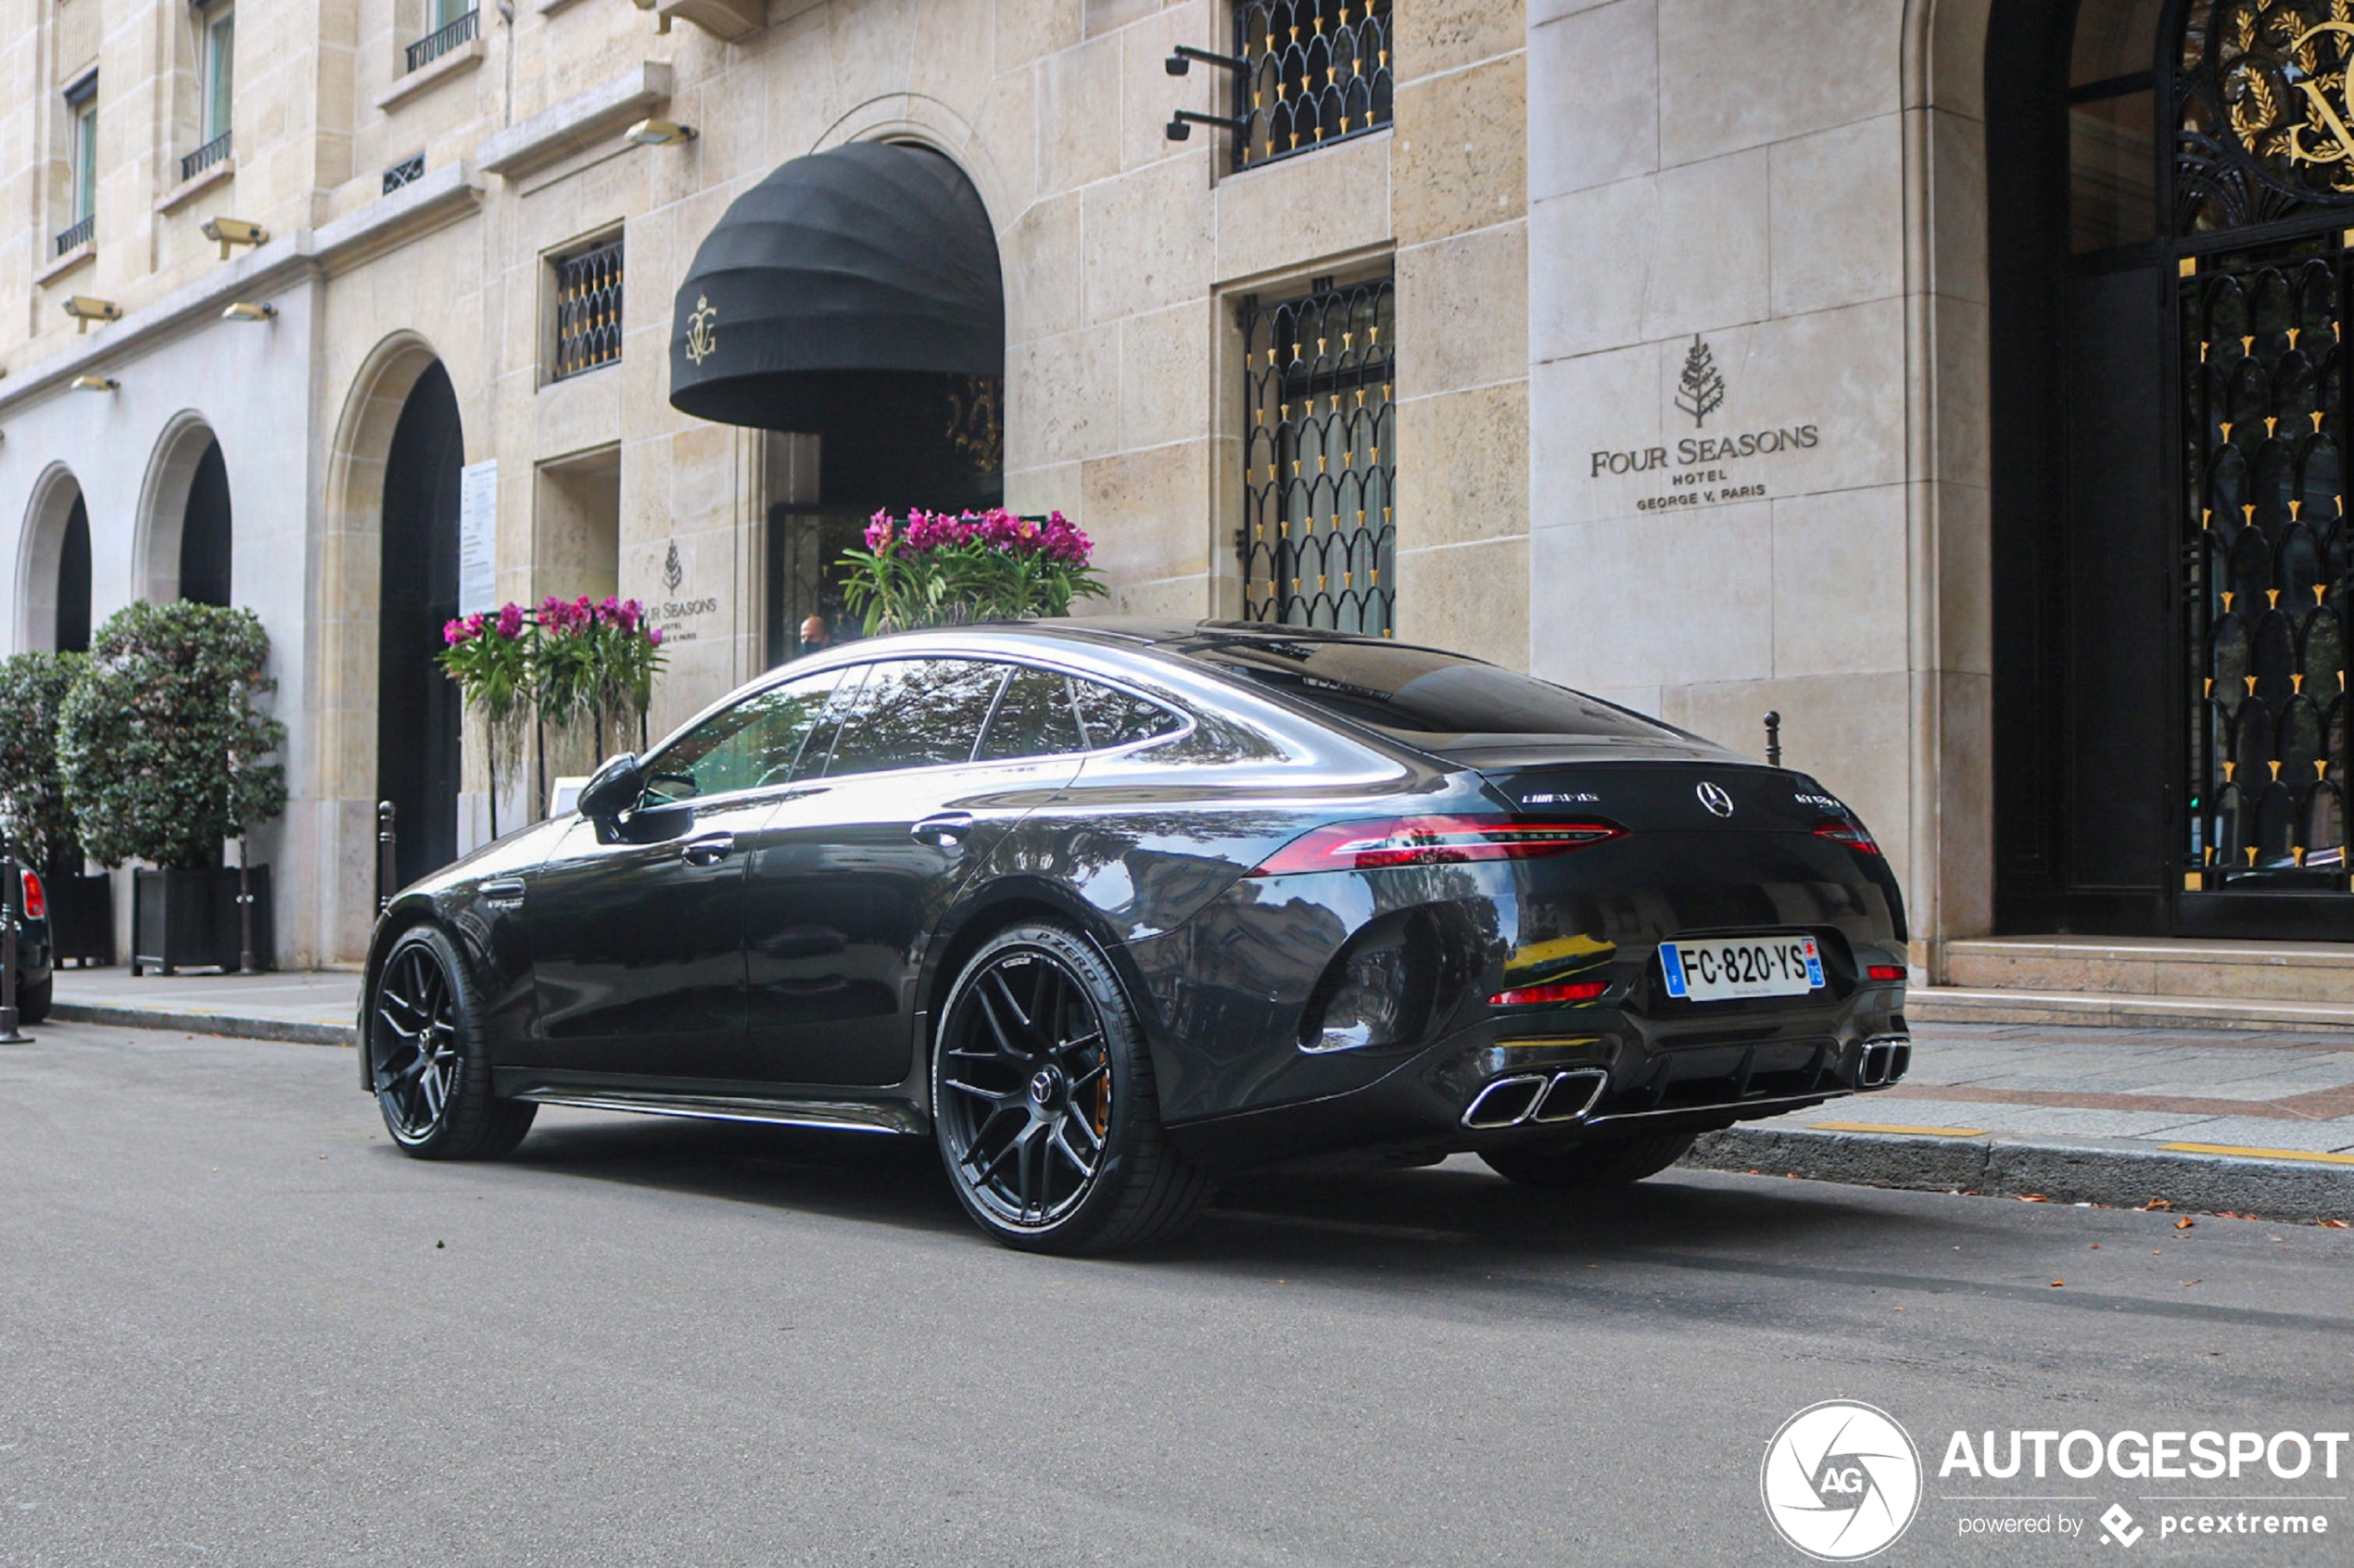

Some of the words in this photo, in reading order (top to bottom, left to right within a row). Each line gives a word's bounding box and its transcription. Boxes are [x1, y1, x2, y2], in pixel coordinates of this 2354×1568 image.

[1590, 447, 1667, 477] FOUR
[1677, 425, 1818, 465] SEASONS
[1672, 469, 1728, 487] HOTEL
[1637, 492, 1698, 511] GEORGE
[1721, 484, 1766, 499] PARIS
[663, 598, 717, 619] SEASONS
[1051, 938, 1098, 981] ZERO
[1679, 945, 1806, 986] FC-820-YS
